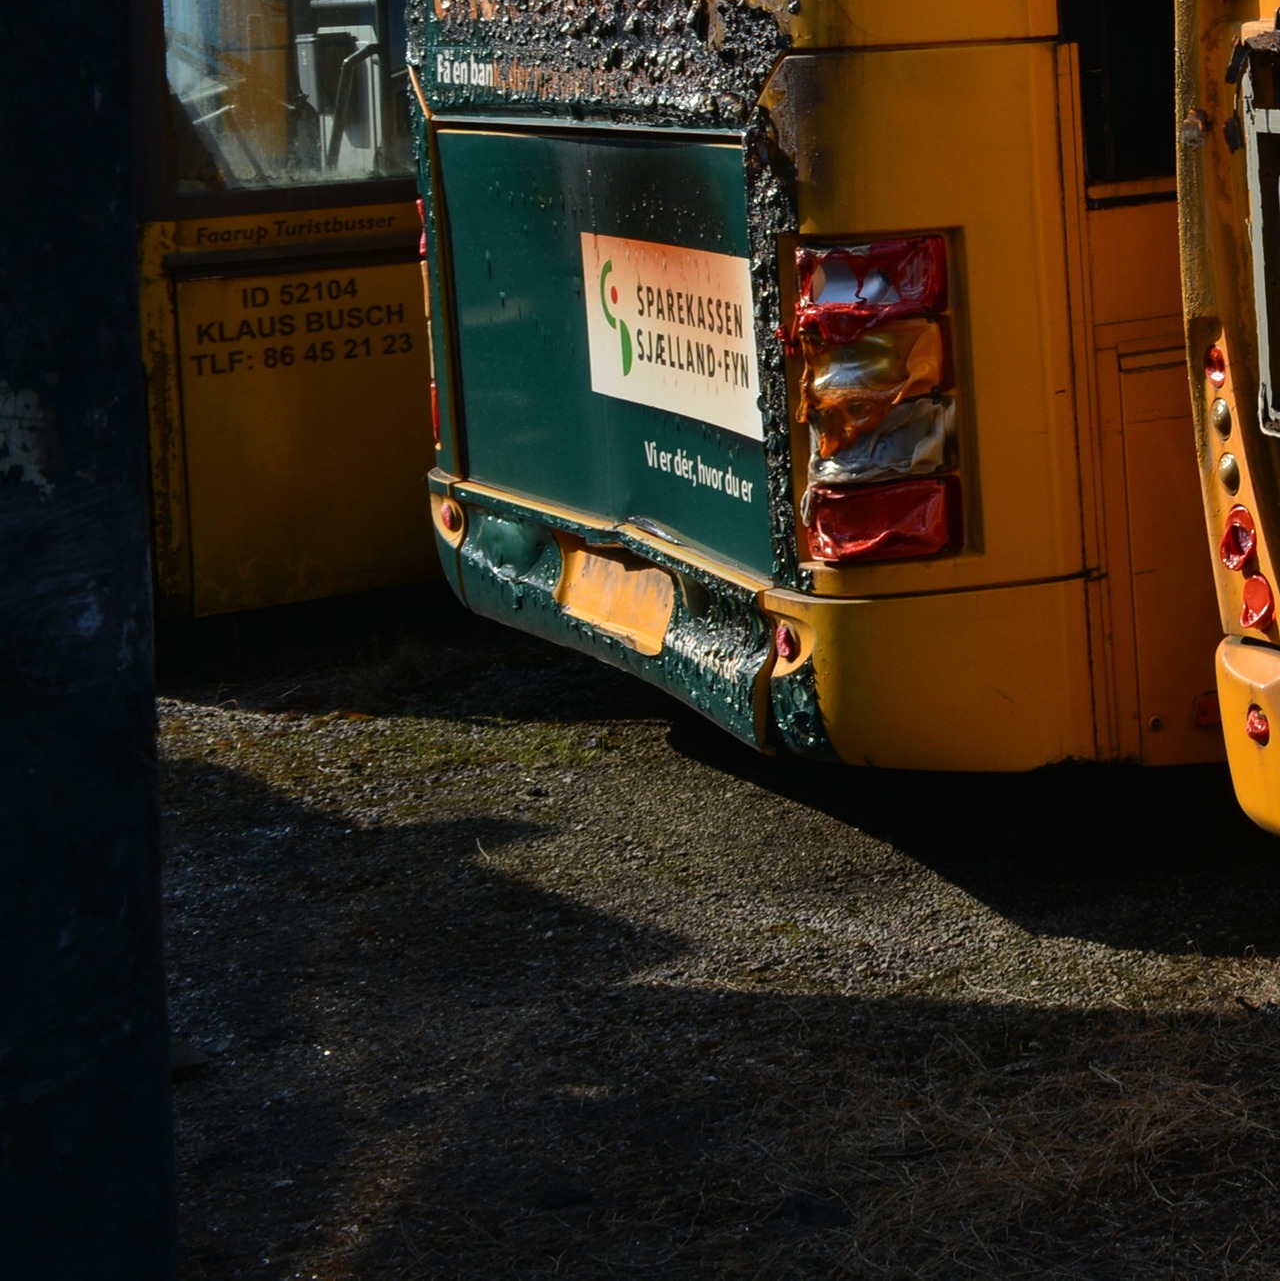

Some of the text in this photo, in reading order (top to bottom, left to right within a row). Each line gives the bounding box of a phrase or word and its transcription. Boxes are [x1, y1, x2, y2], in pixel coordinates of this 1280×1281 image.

[436, 49, 451, 84] Få
[453, 60, 468, 86] en
[196, 215, 396, 245] Faarup Turistbusser
[242, 278, 358, 309] ID 52104
[636, 284, 743, 339] SPAREKASSEN
[196, 303, 405, 345] KLAUS BUSCH
[191, 332, 413, 376] TLF: 86 45 21 23
[636, 328, 750, 389] SJÆLLAND-FYN
[644, 440, 753, 503] Vi er dér, hvor du er
